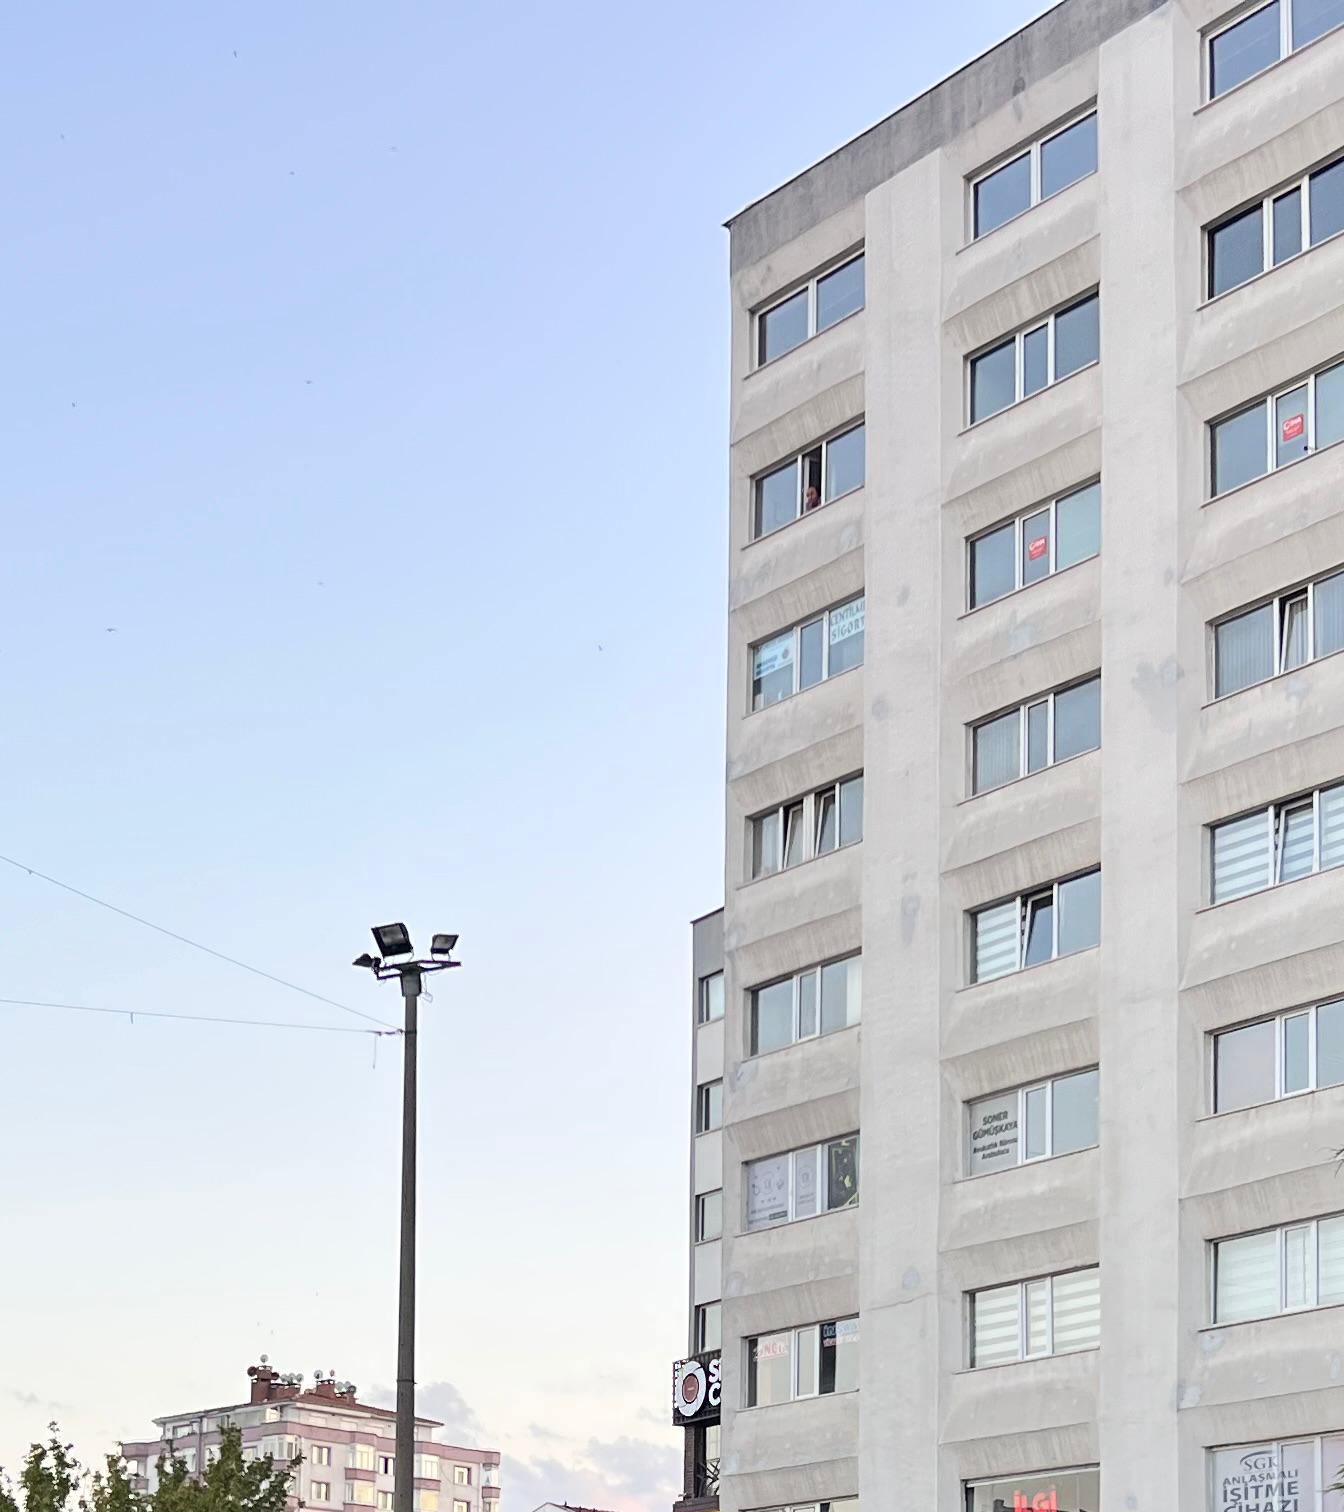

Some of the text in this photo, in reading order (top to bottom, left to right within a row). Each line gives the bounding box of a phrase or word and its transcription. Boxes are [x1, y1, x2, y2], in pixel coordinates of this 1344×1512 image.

[1244, 1456, 1278, 1472] SGK
[1223, 1469, 1298, 1485] ANLAŞMALI
[1223, 1481, 1299, 1505] İŞİTME
